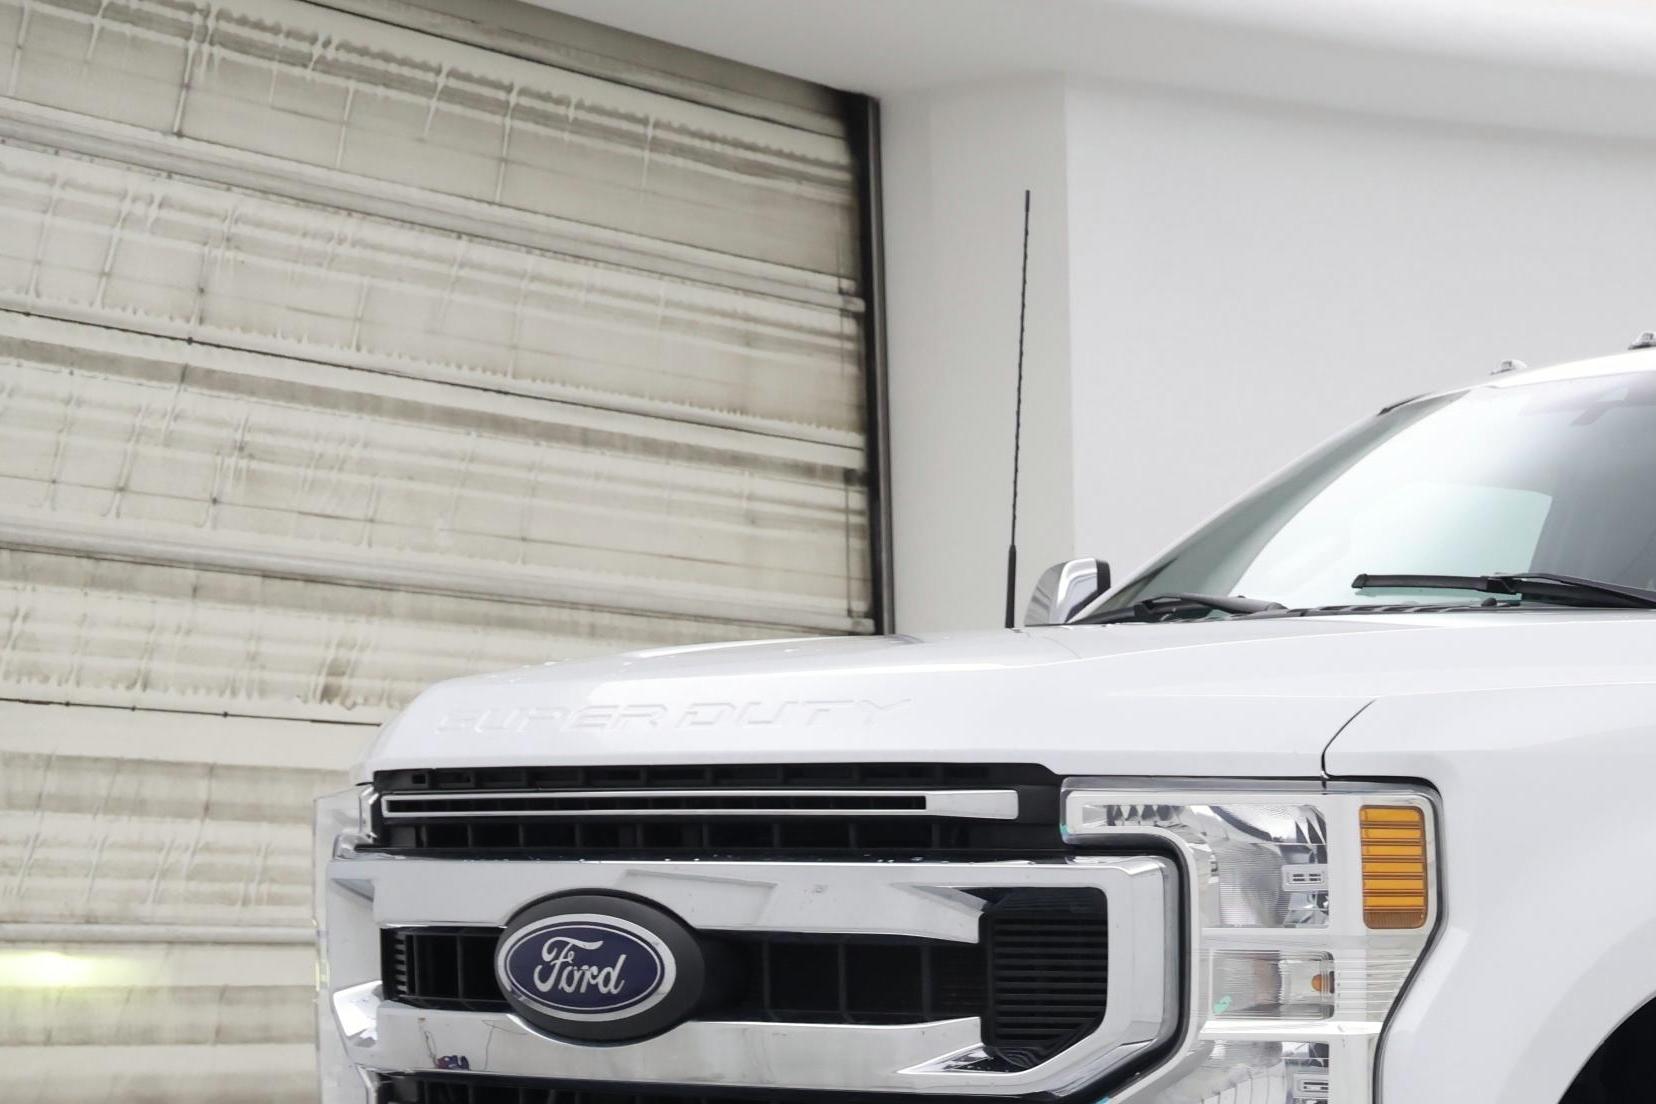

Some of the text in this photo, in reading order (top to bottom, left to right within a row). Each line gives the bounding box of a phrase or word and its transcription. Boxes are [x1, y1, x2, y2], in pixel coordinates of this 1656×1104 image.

[434, 697, 912, 735] SUPER DUTY
[533, 936, 627, 995] Ford
